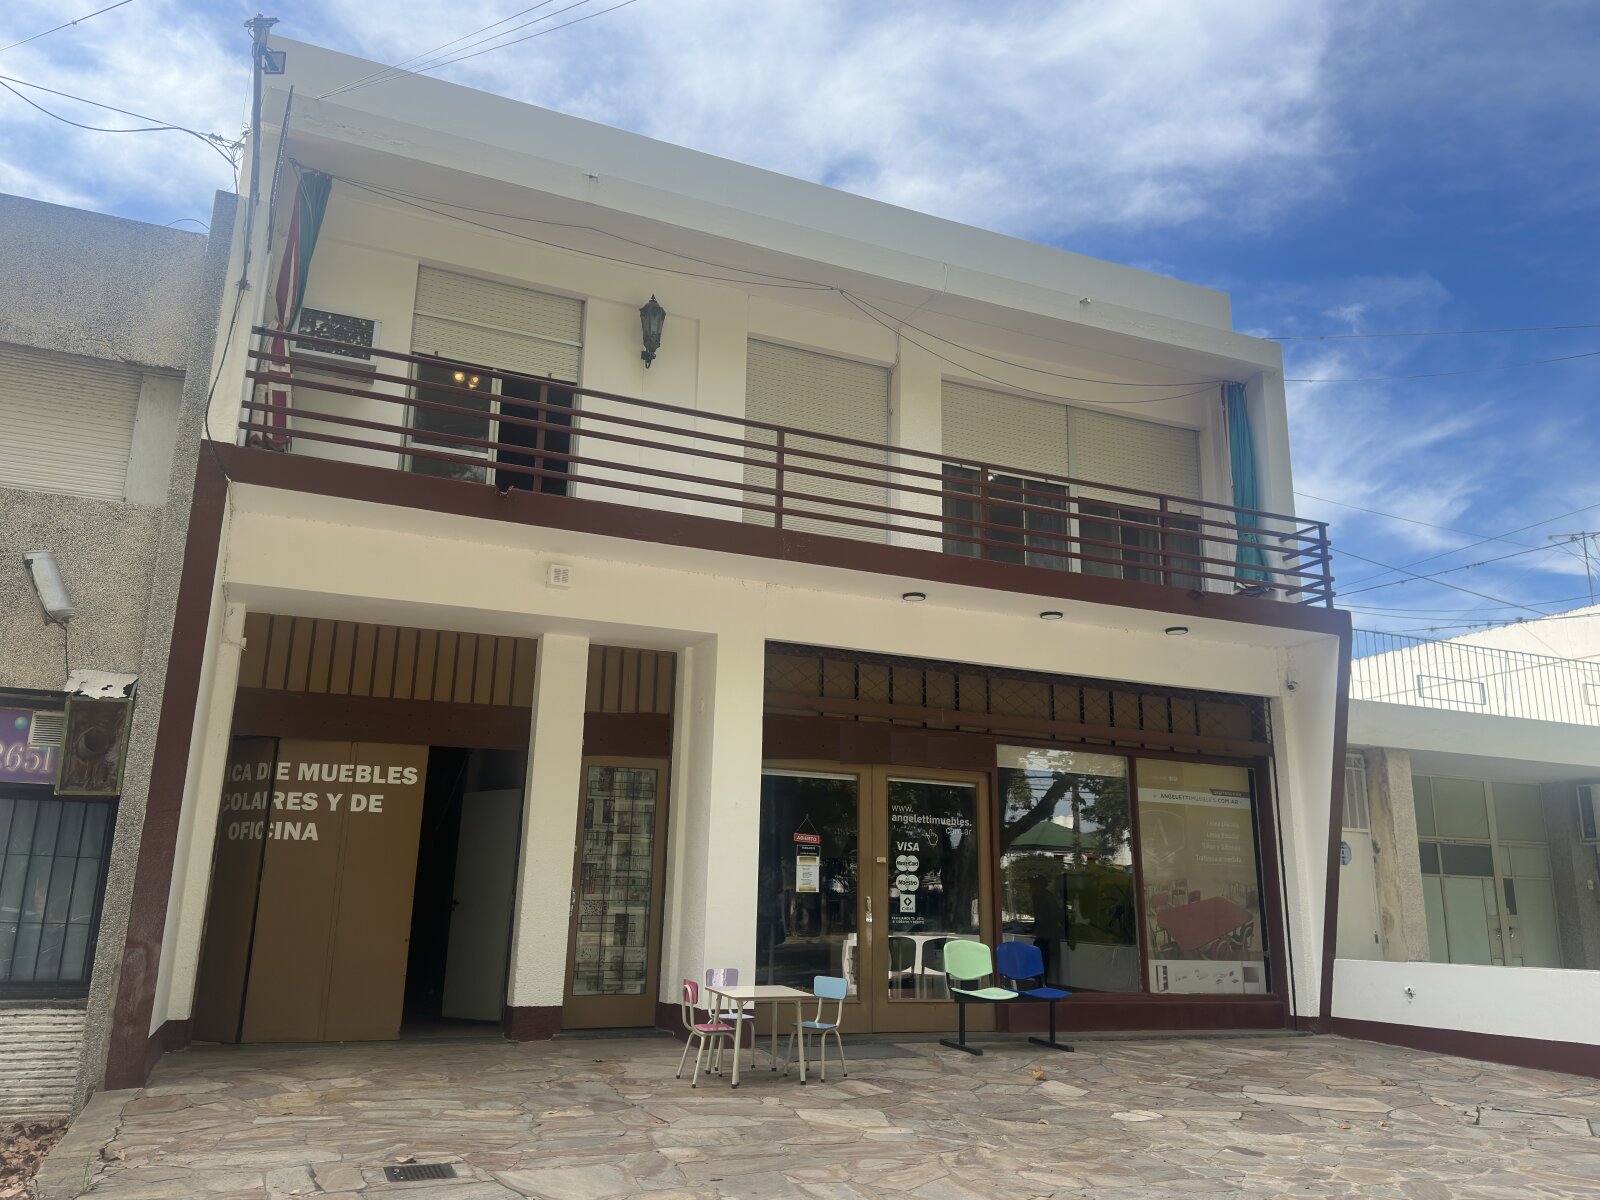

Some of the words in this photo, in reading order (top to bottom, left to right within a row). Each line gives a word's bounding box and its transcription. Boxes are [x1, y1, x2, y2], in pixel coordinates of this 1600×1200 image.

[0, 743, 51, 772] 651
[256, 762, 291, 781] DE
[297, 763, 419, 785] MUEBLES
[326, 793, 344, 812] Y
[349, 794, 385, 813] DE
[891, 804, 914, 813] www.
[891, 814, 972, 826] angelettimuebles.
[228, 821, 319, 841] OFICINA
[896, 841, 920, 852] VISA
